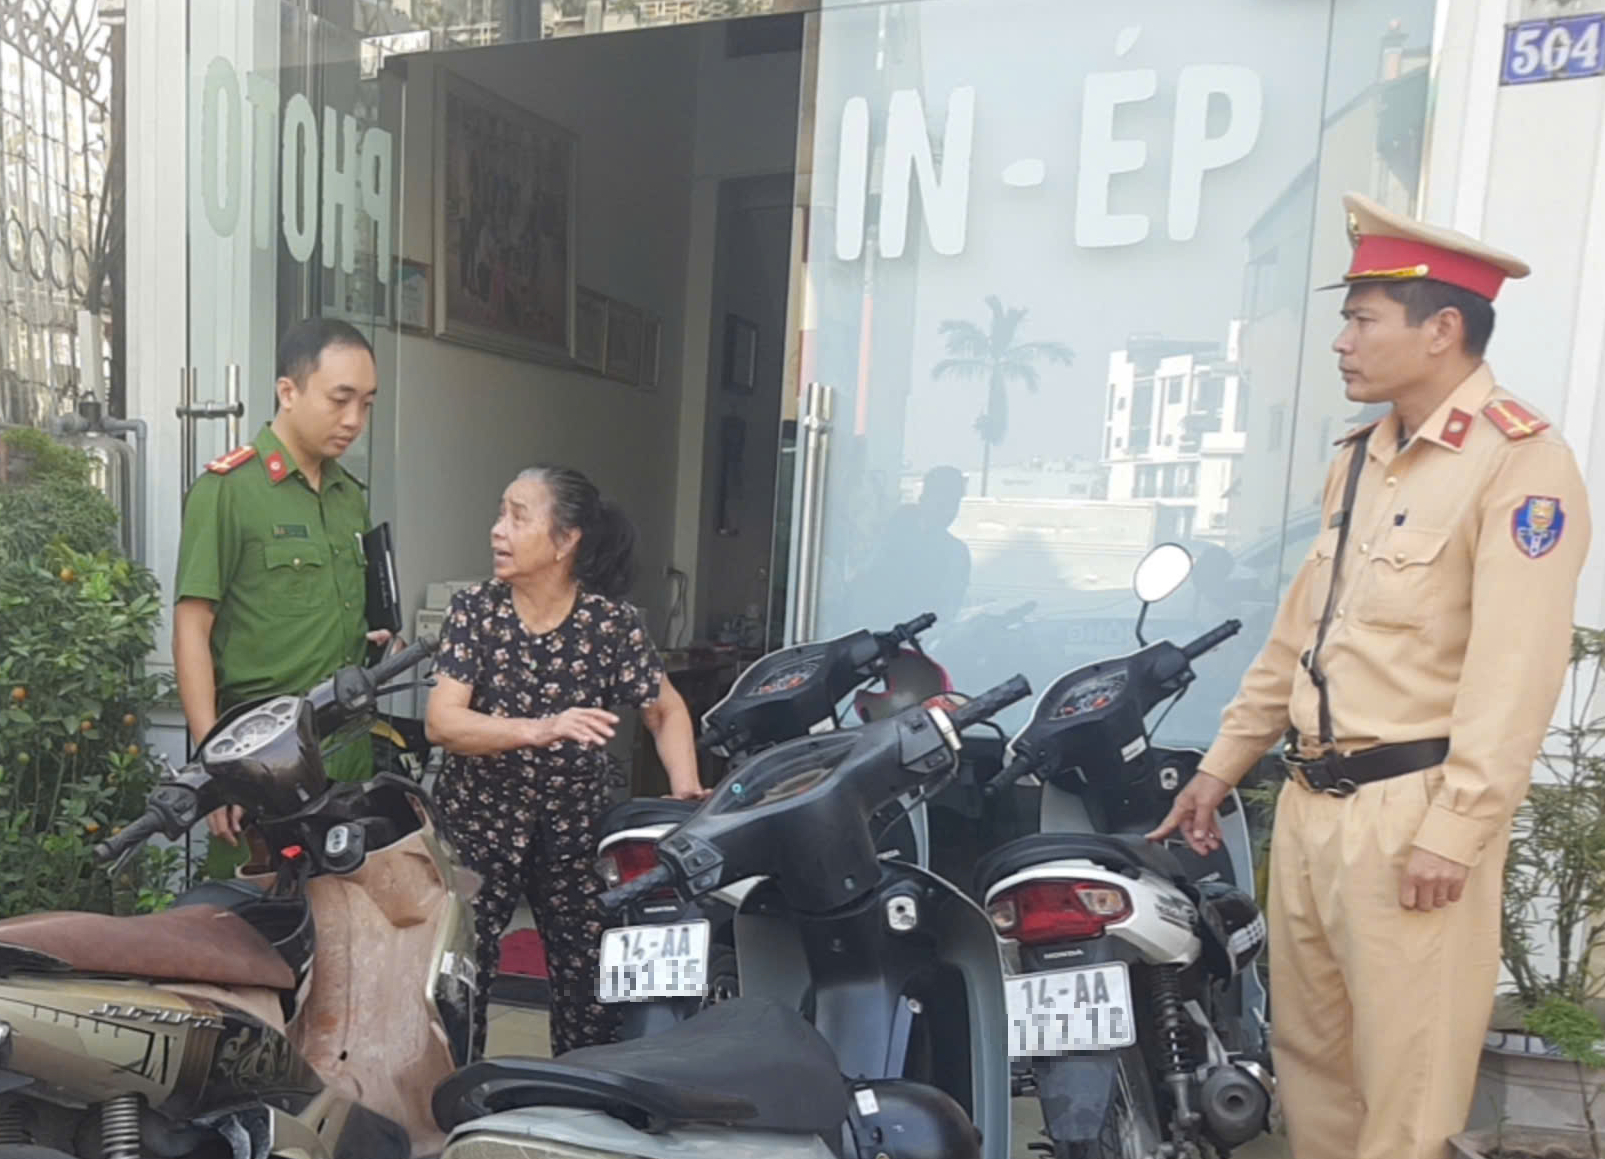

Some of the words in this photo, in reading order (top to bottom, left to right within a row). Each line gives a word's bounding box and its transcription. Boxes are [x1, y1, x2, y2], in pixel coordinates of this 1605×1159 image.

[1512, 22, 1600, 75] 504
[836, 86, 975, 261] IN
[1075, 25, 1263, 248] ÉP
[621, 926, 690, 962] 14-AA
[1021, 971, 1110, 1009] 14-AA
